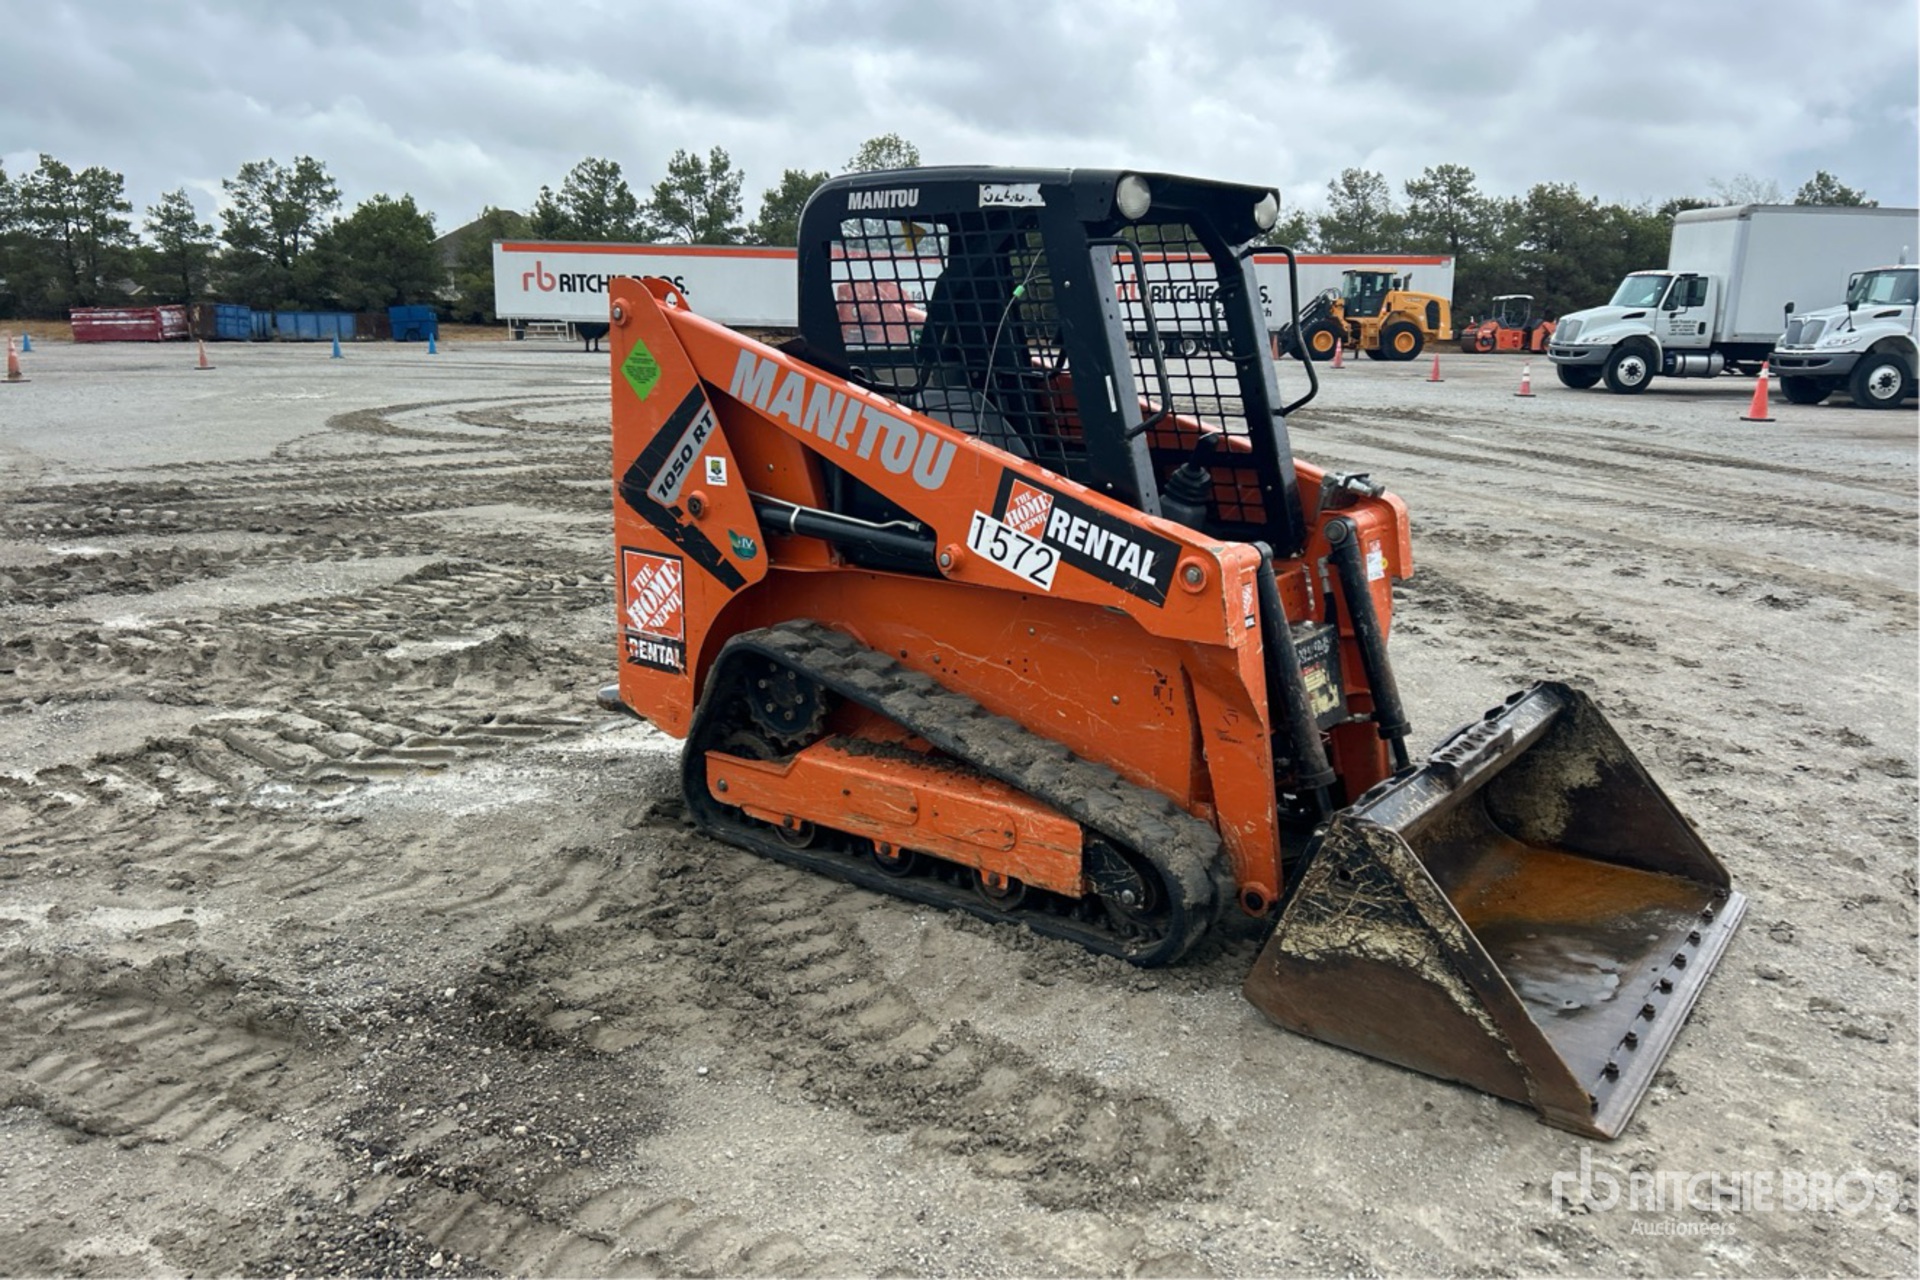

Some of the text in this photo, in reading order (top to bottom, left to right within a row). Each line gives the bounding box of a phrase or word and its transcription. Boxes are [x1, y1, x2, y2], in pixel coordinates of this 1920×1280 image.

[848, 188, 919, 210] MANITOU
[522, 260, 557, 292] rb
[728, 348, 958, 491] MANITOU
[656, 409, 713, 499] 1050 RT
[1006, 492, 1051, 528] HOME
[1014, 490, 1032, 506] THE
[1019, 512, 1047, 533] DEPOT
[974, 514, 1054, 587] 1572
[1047, 507, 1157, 586] RENTAL
[626, 558, 682, 630] HOME
[631, 562, 654, 593] THE
[649, 590, 683, 629] DEPOT
[628, 636, 685, 669] RENTAL
